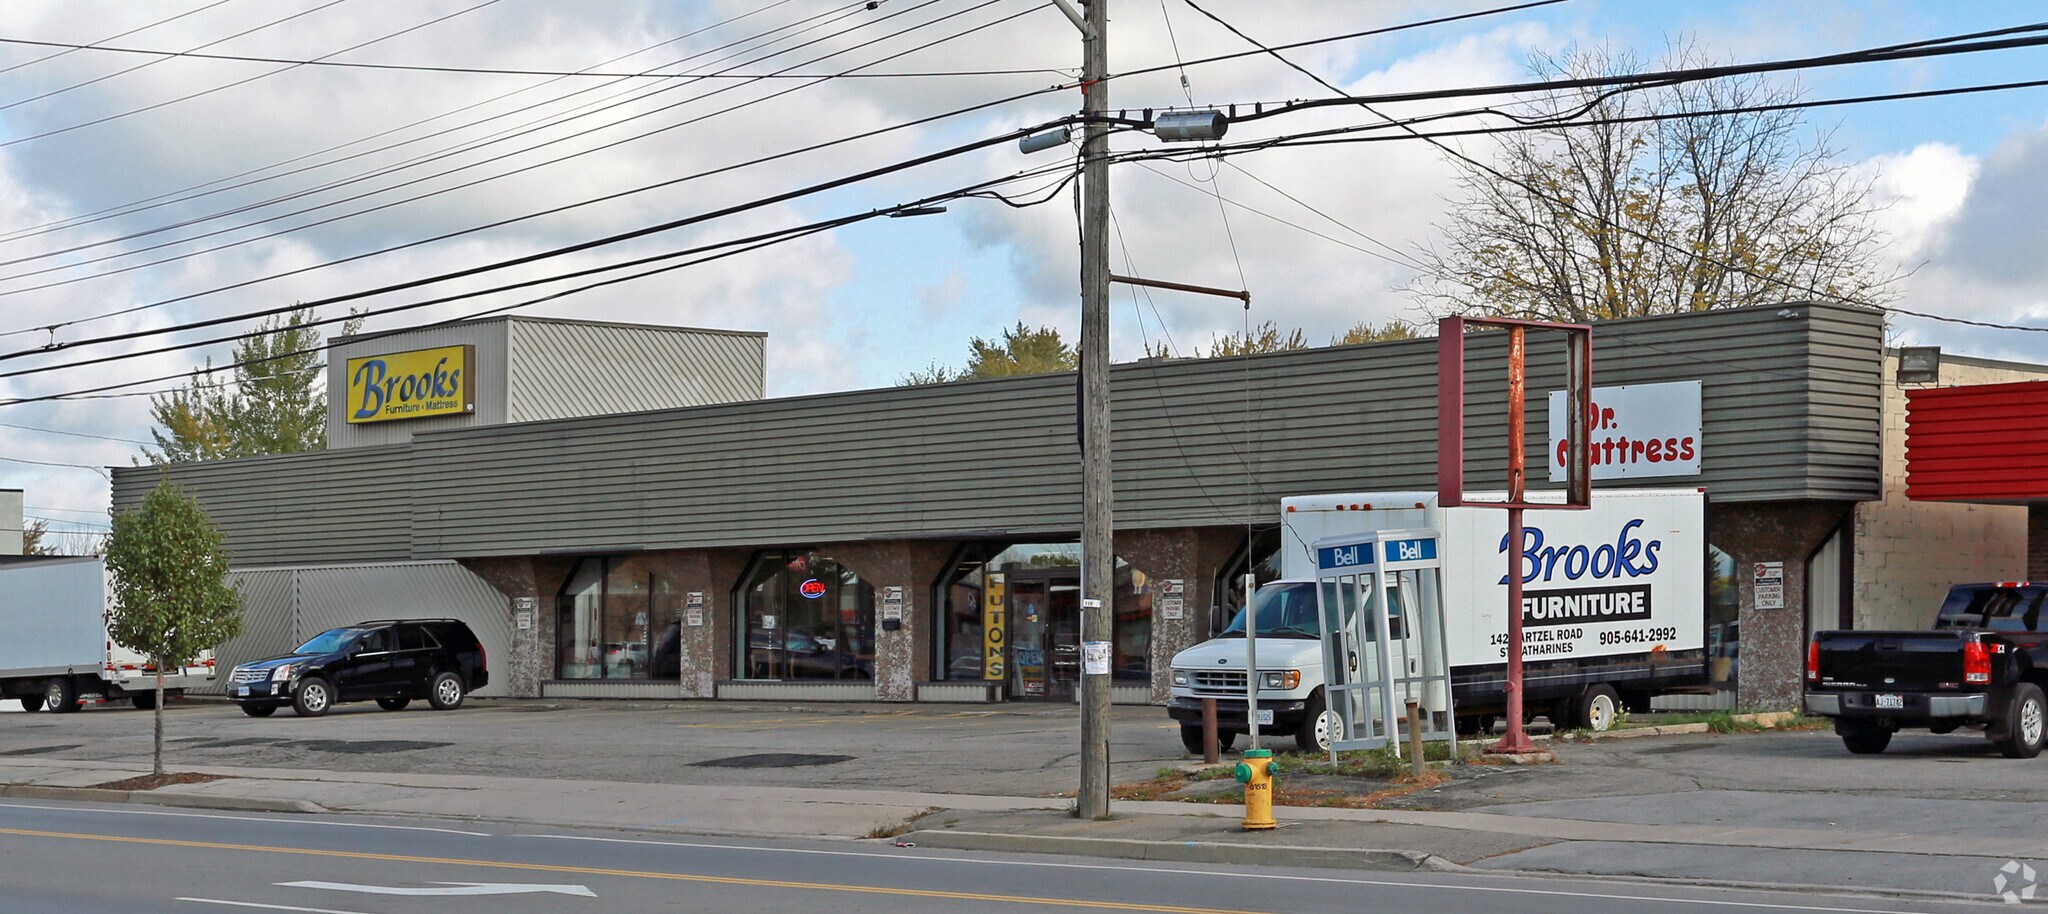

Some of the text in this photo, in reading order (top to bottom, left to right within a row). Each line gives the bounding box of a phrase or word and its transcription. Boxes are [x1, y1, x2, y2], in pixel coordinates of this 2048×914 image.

[353, 357, 460, 419] Brooks
[385, 400, 458, 415] Furniture Mattress
[1334, 546, 1358, 566] Bell
[1399, 541, 1422, 560] Bell
[1498, 519, 1661, 585] Brooks
[1521, 591, 1645, 620] FURNITURE
[988, 576, 1004, 676] FUTONS
[1521, 630, 1554, 643] RTZEL
[1557, 628, 1583, 640] ROAD
[1599, 627, 1677, 645] 905-641-2992
[1018, 650, 1044, 664] OPEN
[1500, 642, 1573, 658] S ATHARINES
